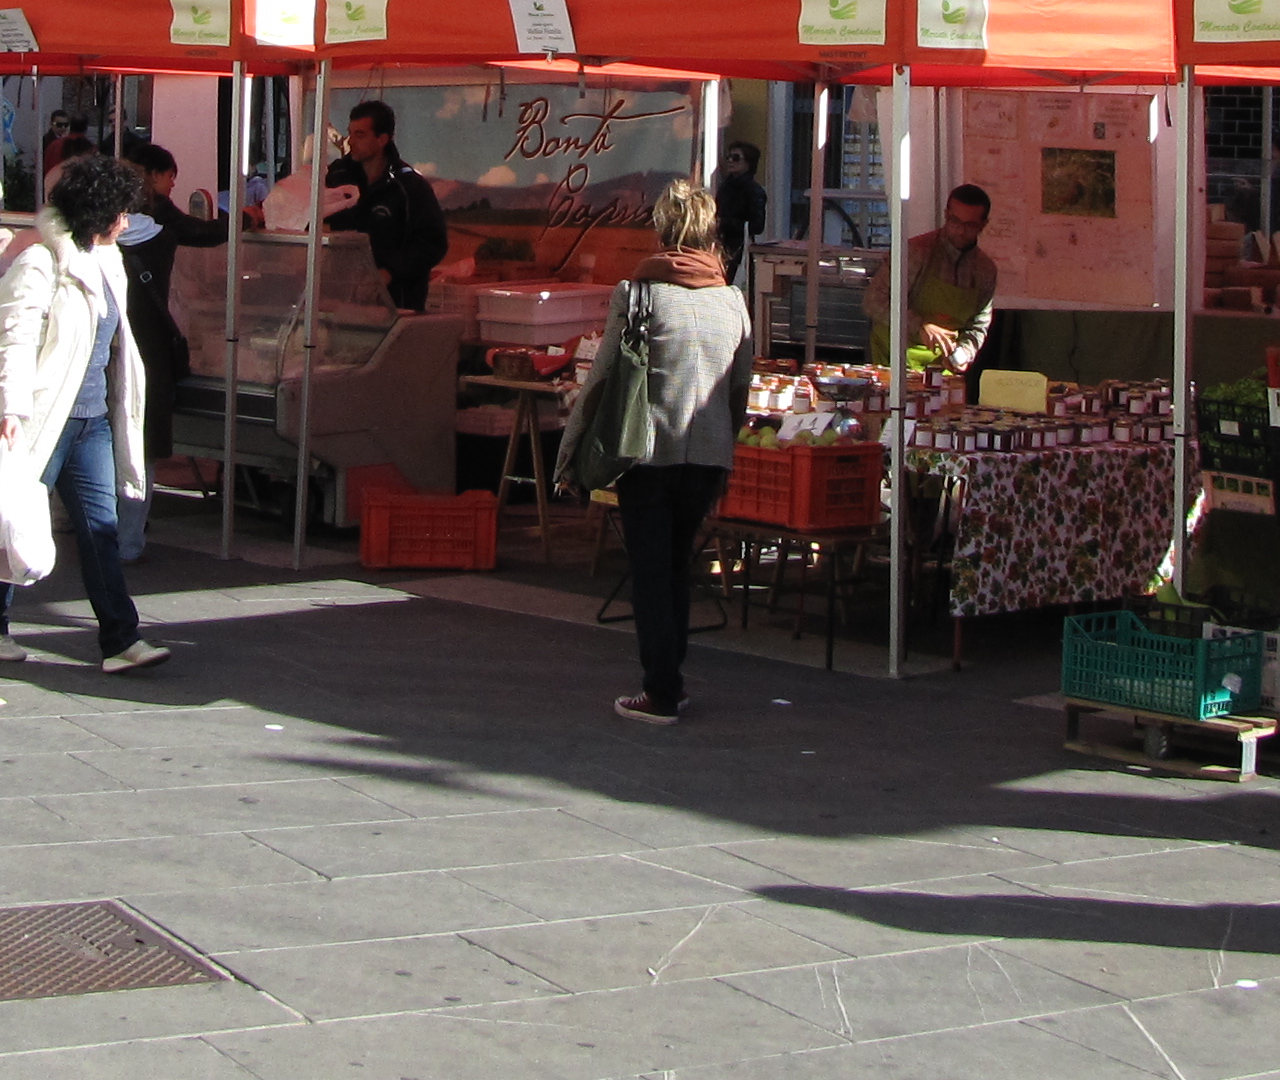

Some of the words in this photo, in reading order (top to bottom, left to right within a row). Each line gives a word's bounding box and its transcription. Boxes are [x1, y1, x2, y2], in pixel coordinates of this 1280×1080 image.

[801, 24, 837, 35] Mercato
[839, 25, 882, 37] Contadino
[1199, 21, 1240, 33] Mercato
[505, 96, 686, 161] Bontà
